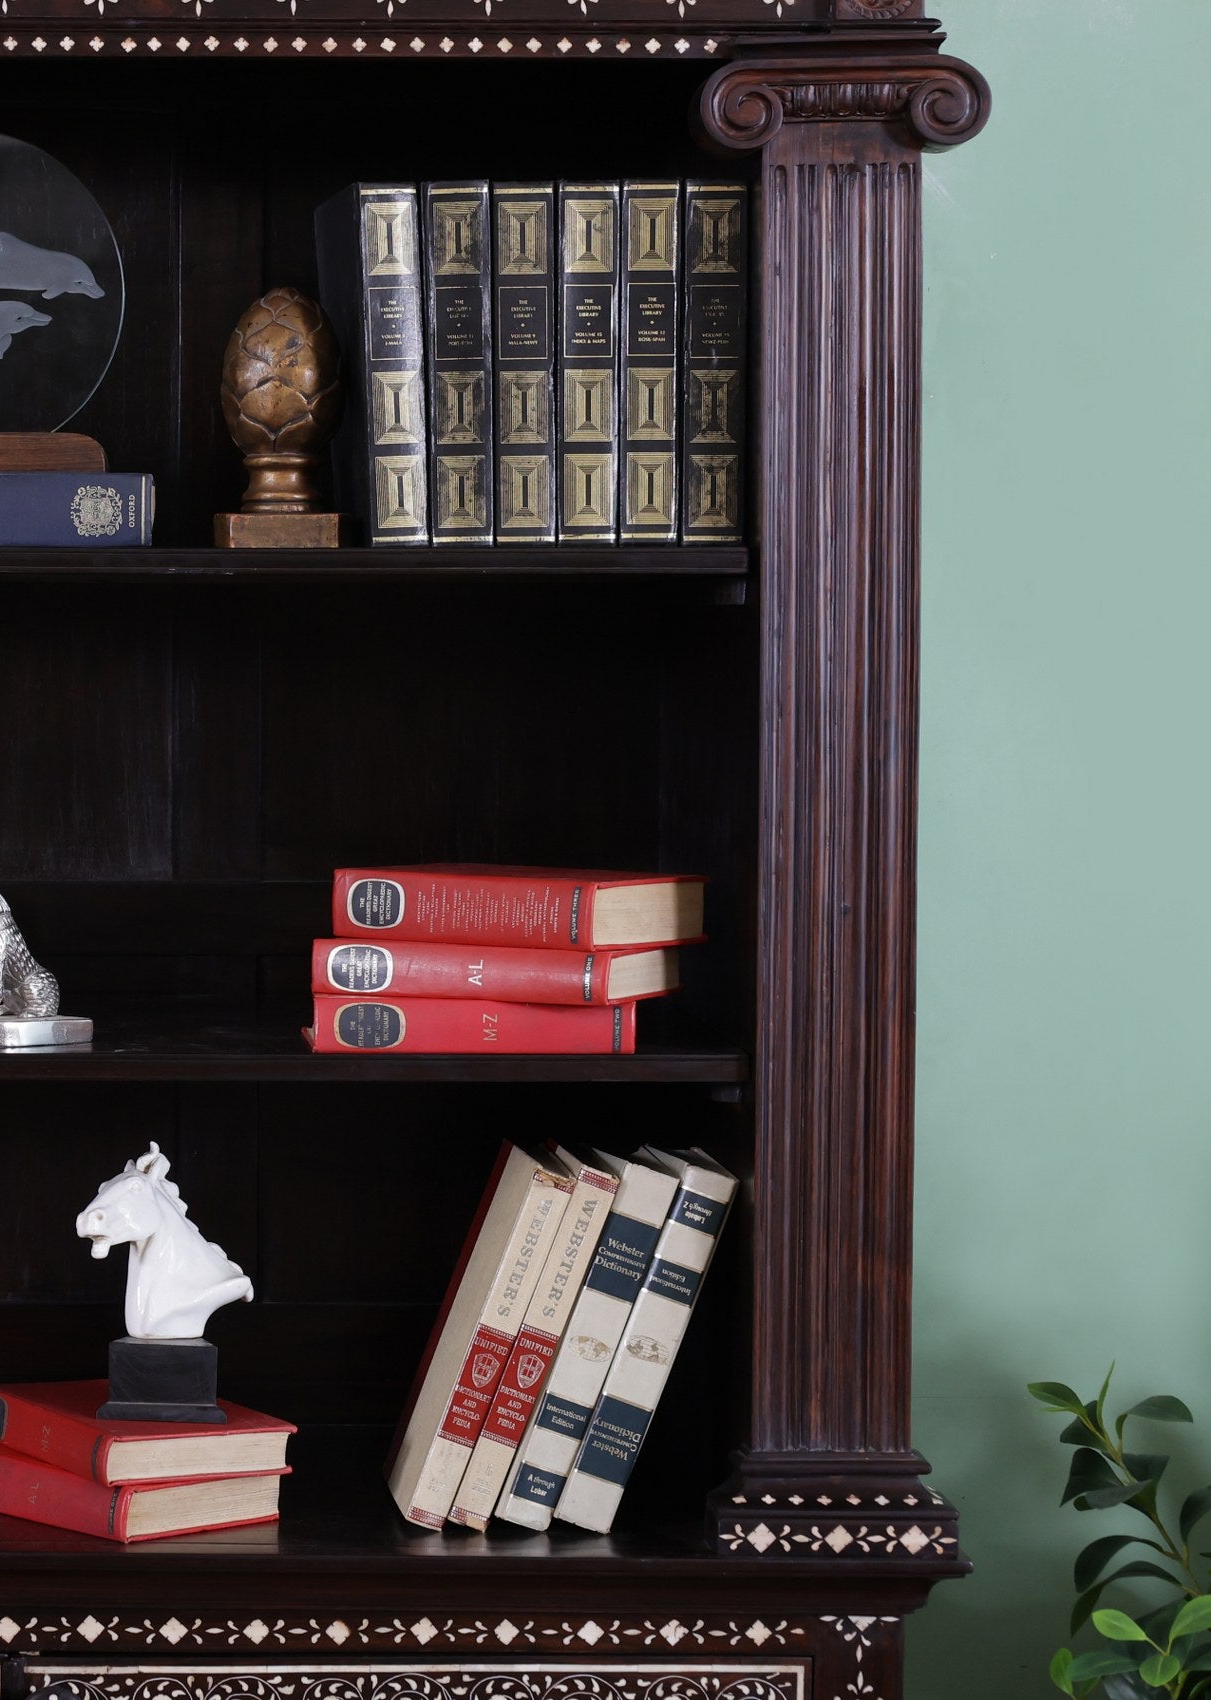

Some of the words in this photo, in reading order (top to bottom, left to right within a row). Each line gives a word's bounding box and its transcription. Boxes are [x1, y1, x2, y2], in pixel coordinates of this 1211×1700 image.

[468, 960, 483, 986] A-L
[483, 1013, 498, 1041] M-Z
[689, 1202, 712, 1217] through
[608, 1238, 645, 1258] Webster
[498, 1200, 553, 1318] WEBSTER'S
[542, 1200, 599, 1318] WEBSTER'S
[595, 1256, 642, 1281] Dictionary
[662, 1268, 686, 1282] Edition
[649, 1275, 691, 1296] International
[474, 1337, 509, 1356] UNIFIED
[520, 1338, 554, 1357] UNIFIED
[456, 1385, 492, 1403] DICTIONARY
[462, 1399, 477, 1408] AND
[500, 1385, 536, 1404] DICTIONARY
[452, 1406, 481, 1421] ENCYCLO-
[507, 1400, 522, 1409] AND
[546, 1403, 586, 1422] International
[452, 1417, 471, 1429] PEDIA
[497, 1407, 526, 1422] ENCYCLO-
[497, 1418, 516, 1430] PEDIA
[551, 1416, 574, 1429] Edition
[592, 1417, 642, 1443] Dictionary
[592, 1440, 628, 1461] Webster
[533, 1476, 555, 1489] through
